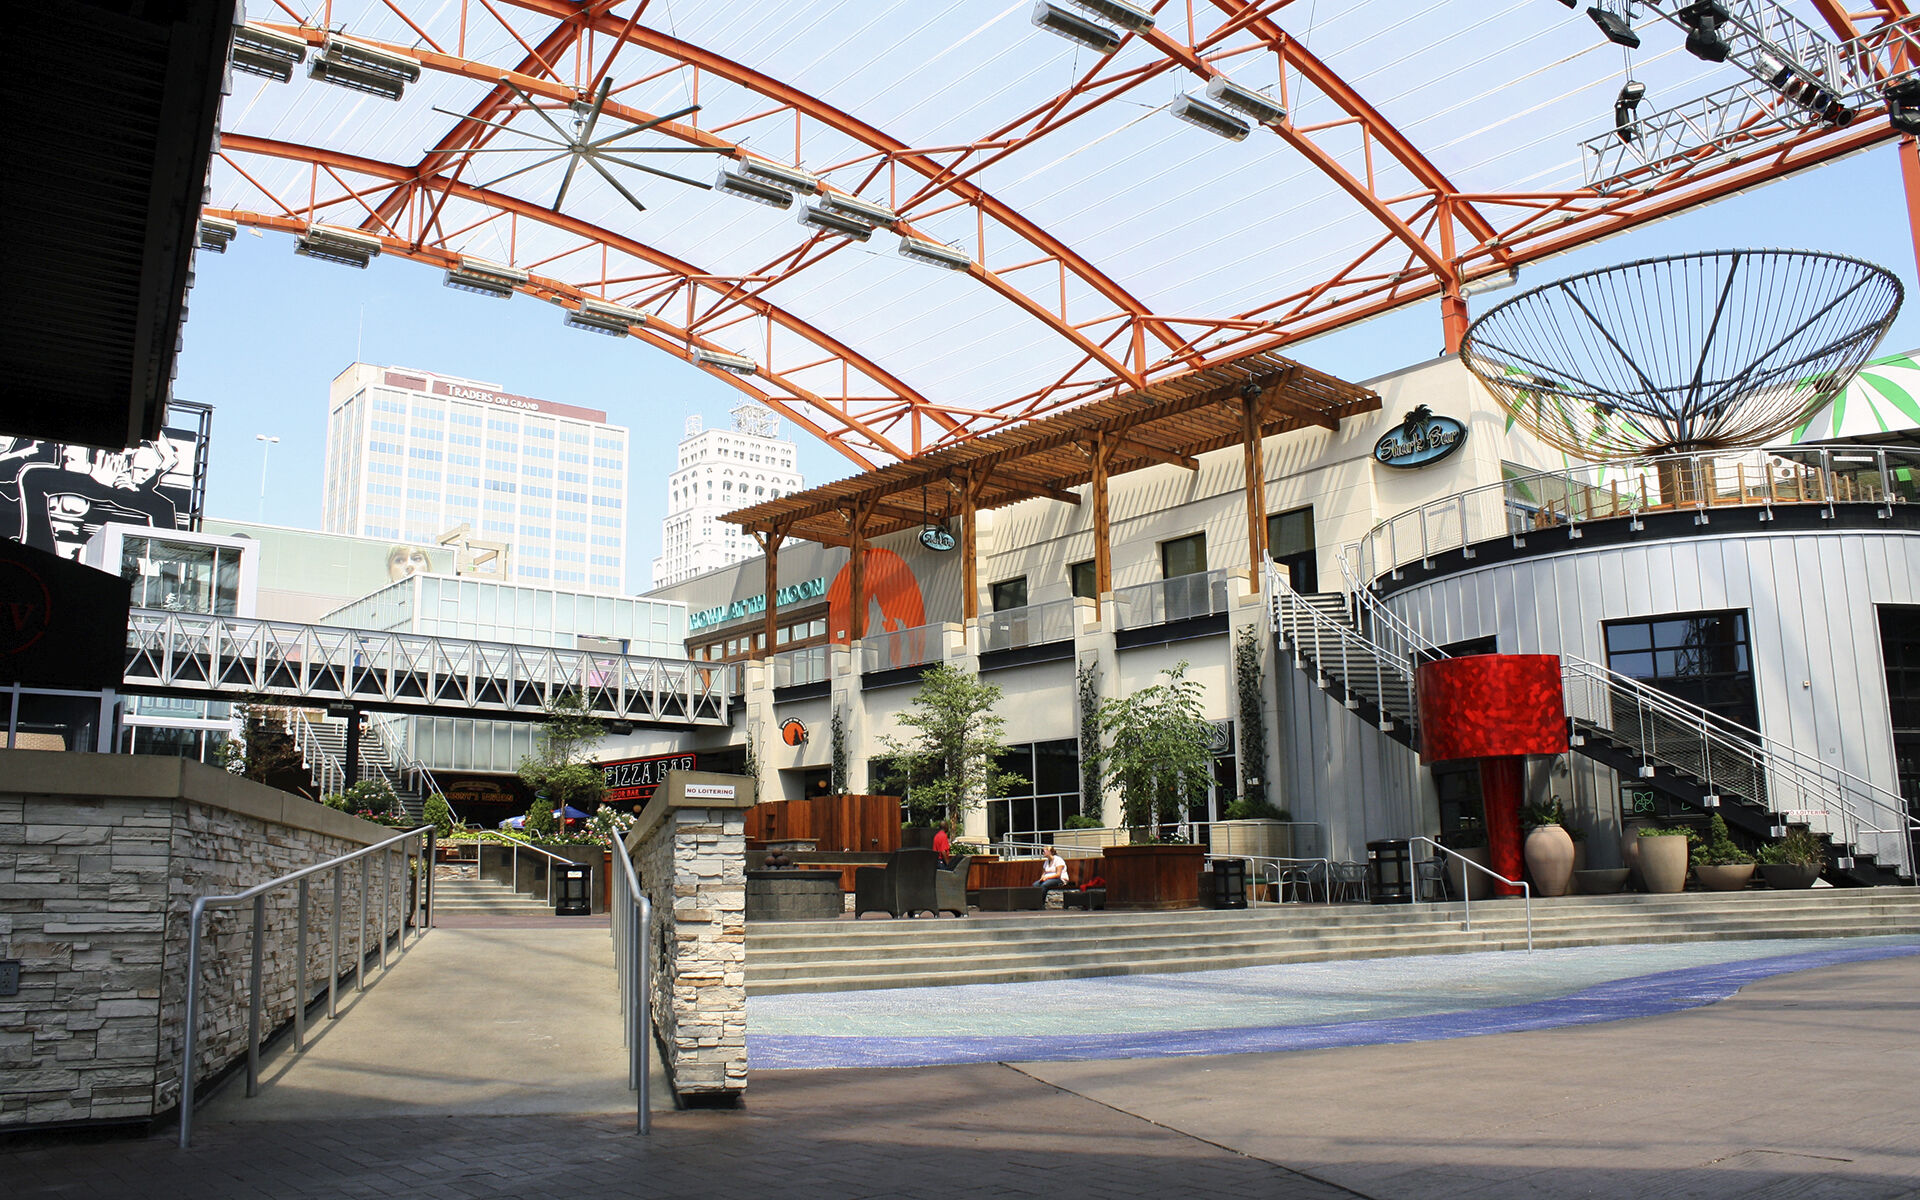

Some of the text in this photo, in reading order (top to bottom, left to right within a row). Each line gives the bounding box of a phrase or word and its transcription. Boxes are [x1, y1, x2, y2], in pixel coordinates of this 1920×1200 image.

[447, 384, 540, 411] TRADERS ON GRAND
[1380, 424, 1459, 461] Shark Bar
[690, 577, 825, 630] HOWL AT TH MOON
[604, 763, 652, 787] PIZZA
